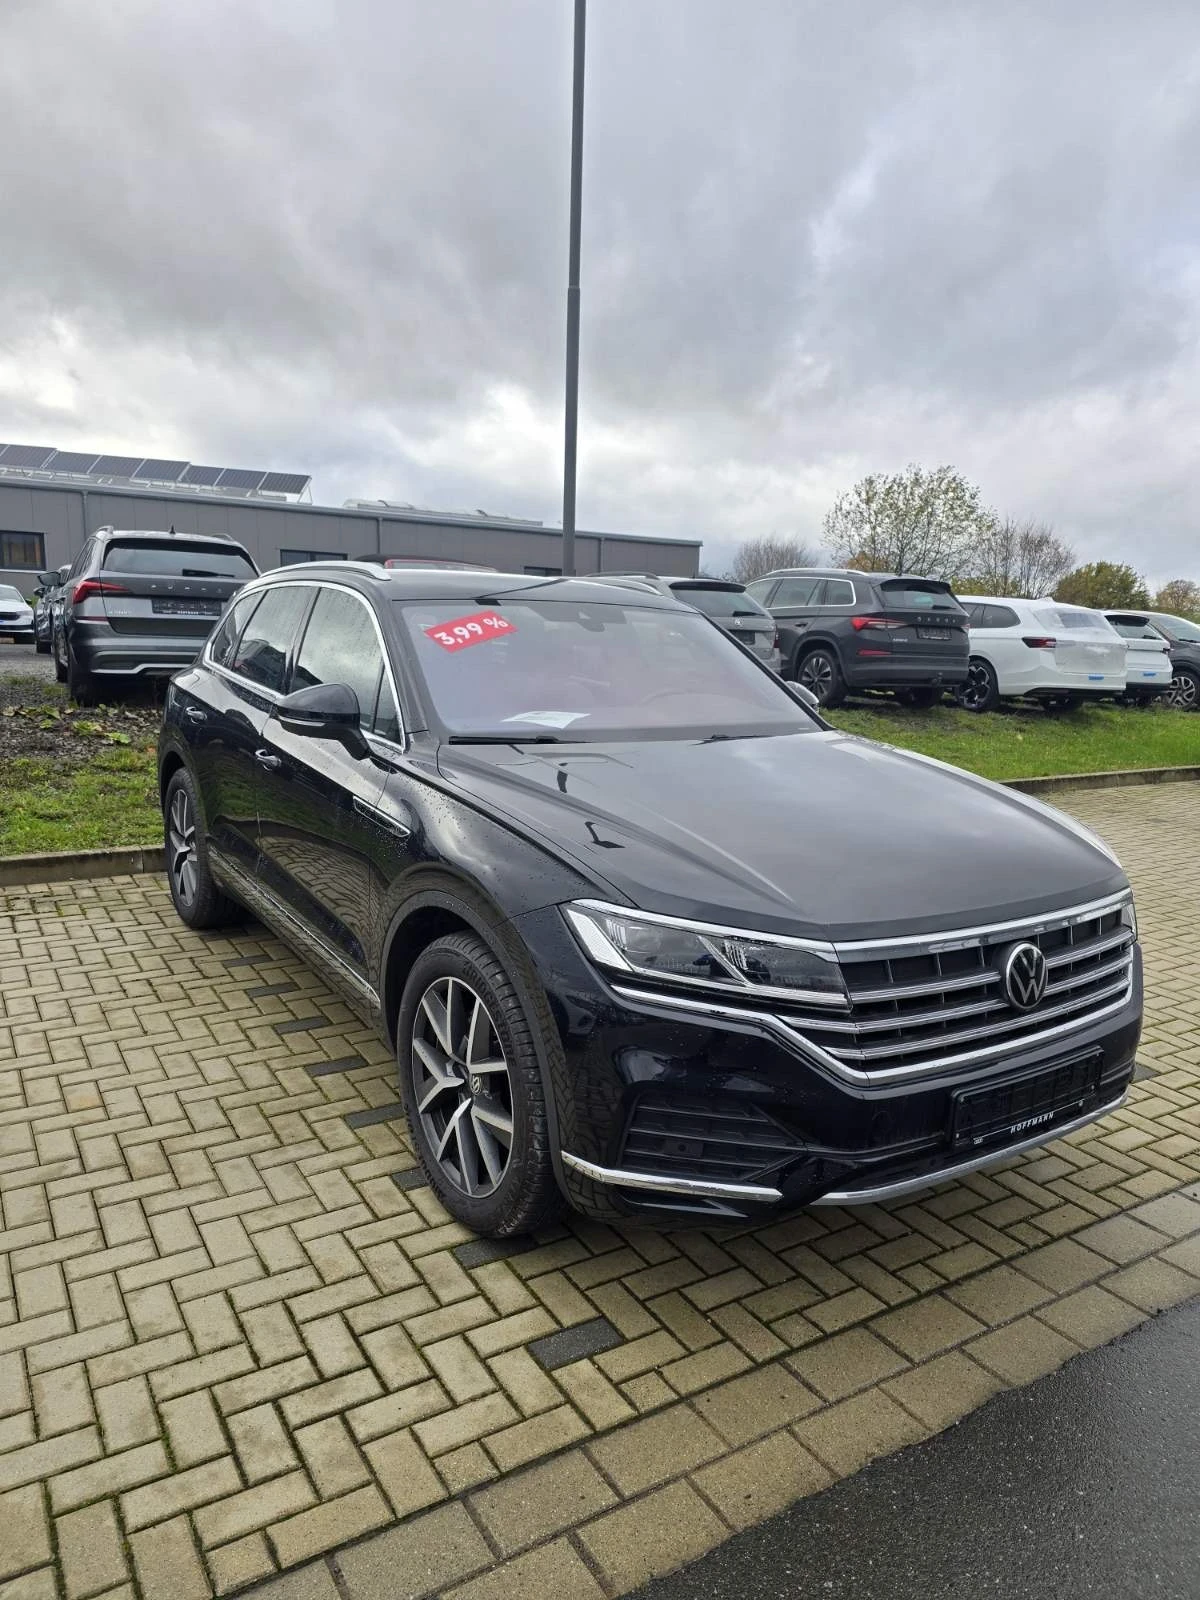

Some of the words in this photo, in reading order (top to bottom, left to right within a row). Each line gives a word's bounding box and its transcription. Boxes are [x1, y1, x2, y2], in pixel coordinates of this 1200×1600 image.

[433, 622, 483, 645] 3,99
[483, 617, 509, 629] %
[1010, 1111, 1055, 1134] HOFFMANN
